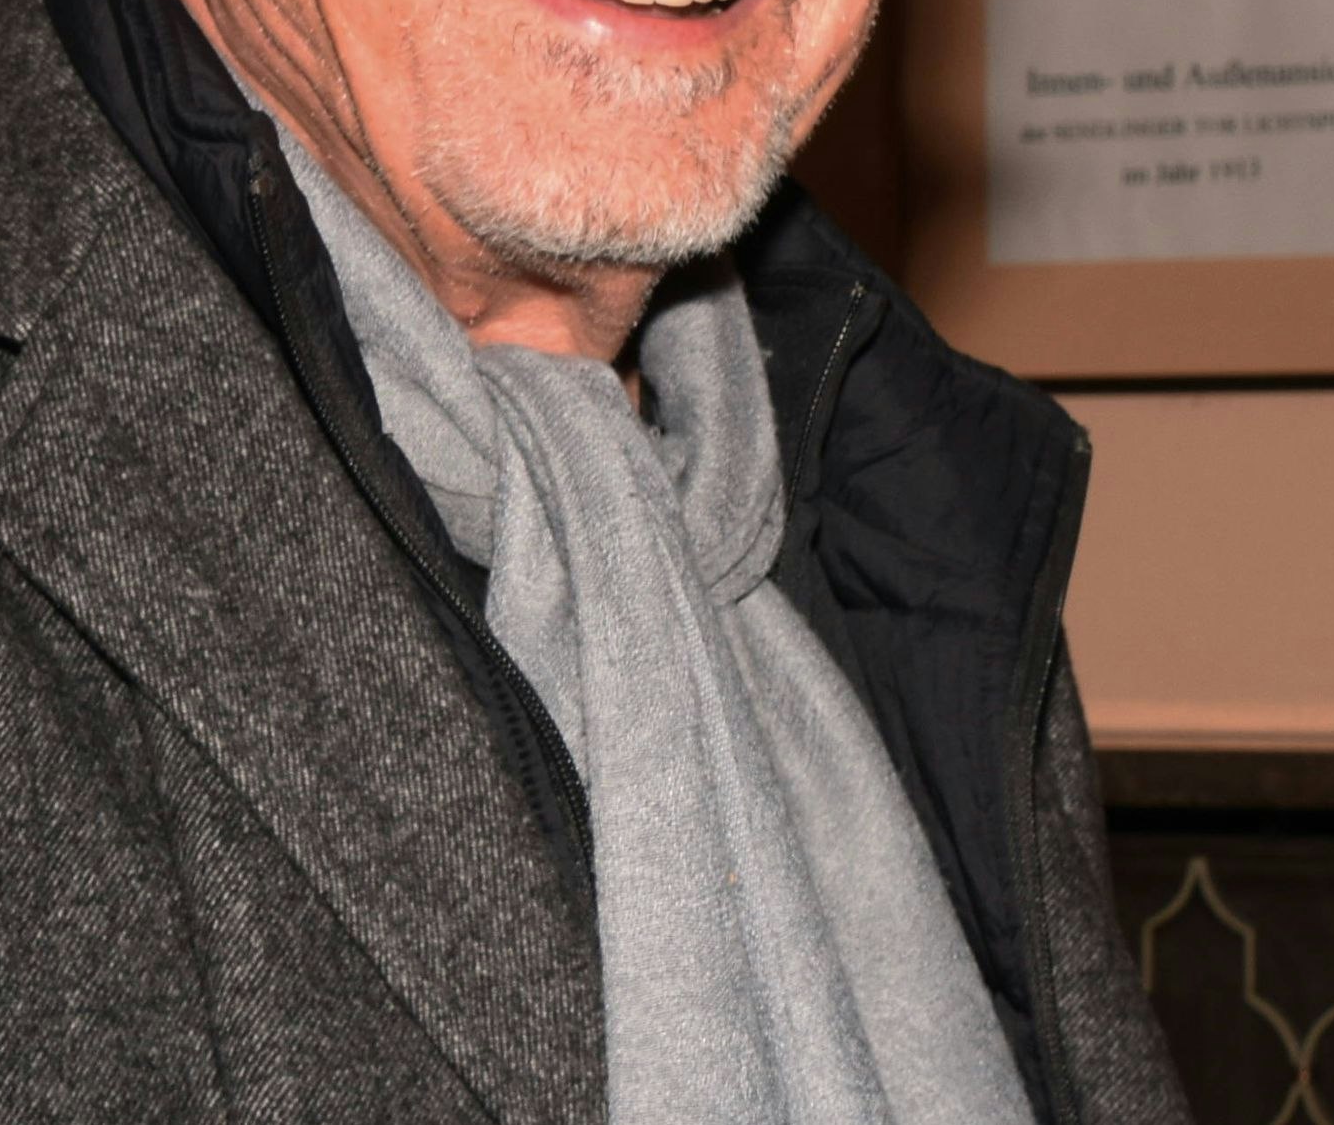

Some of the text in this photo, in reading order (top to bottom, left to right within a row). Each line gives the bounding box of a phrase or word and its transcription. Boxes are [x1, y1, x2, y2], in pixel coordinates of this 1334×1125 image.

[1027, 67, 1109, 96] Innen-
[1123, 62, 1175, 92] und
[1157, 160, 1200, 186] Jahr
